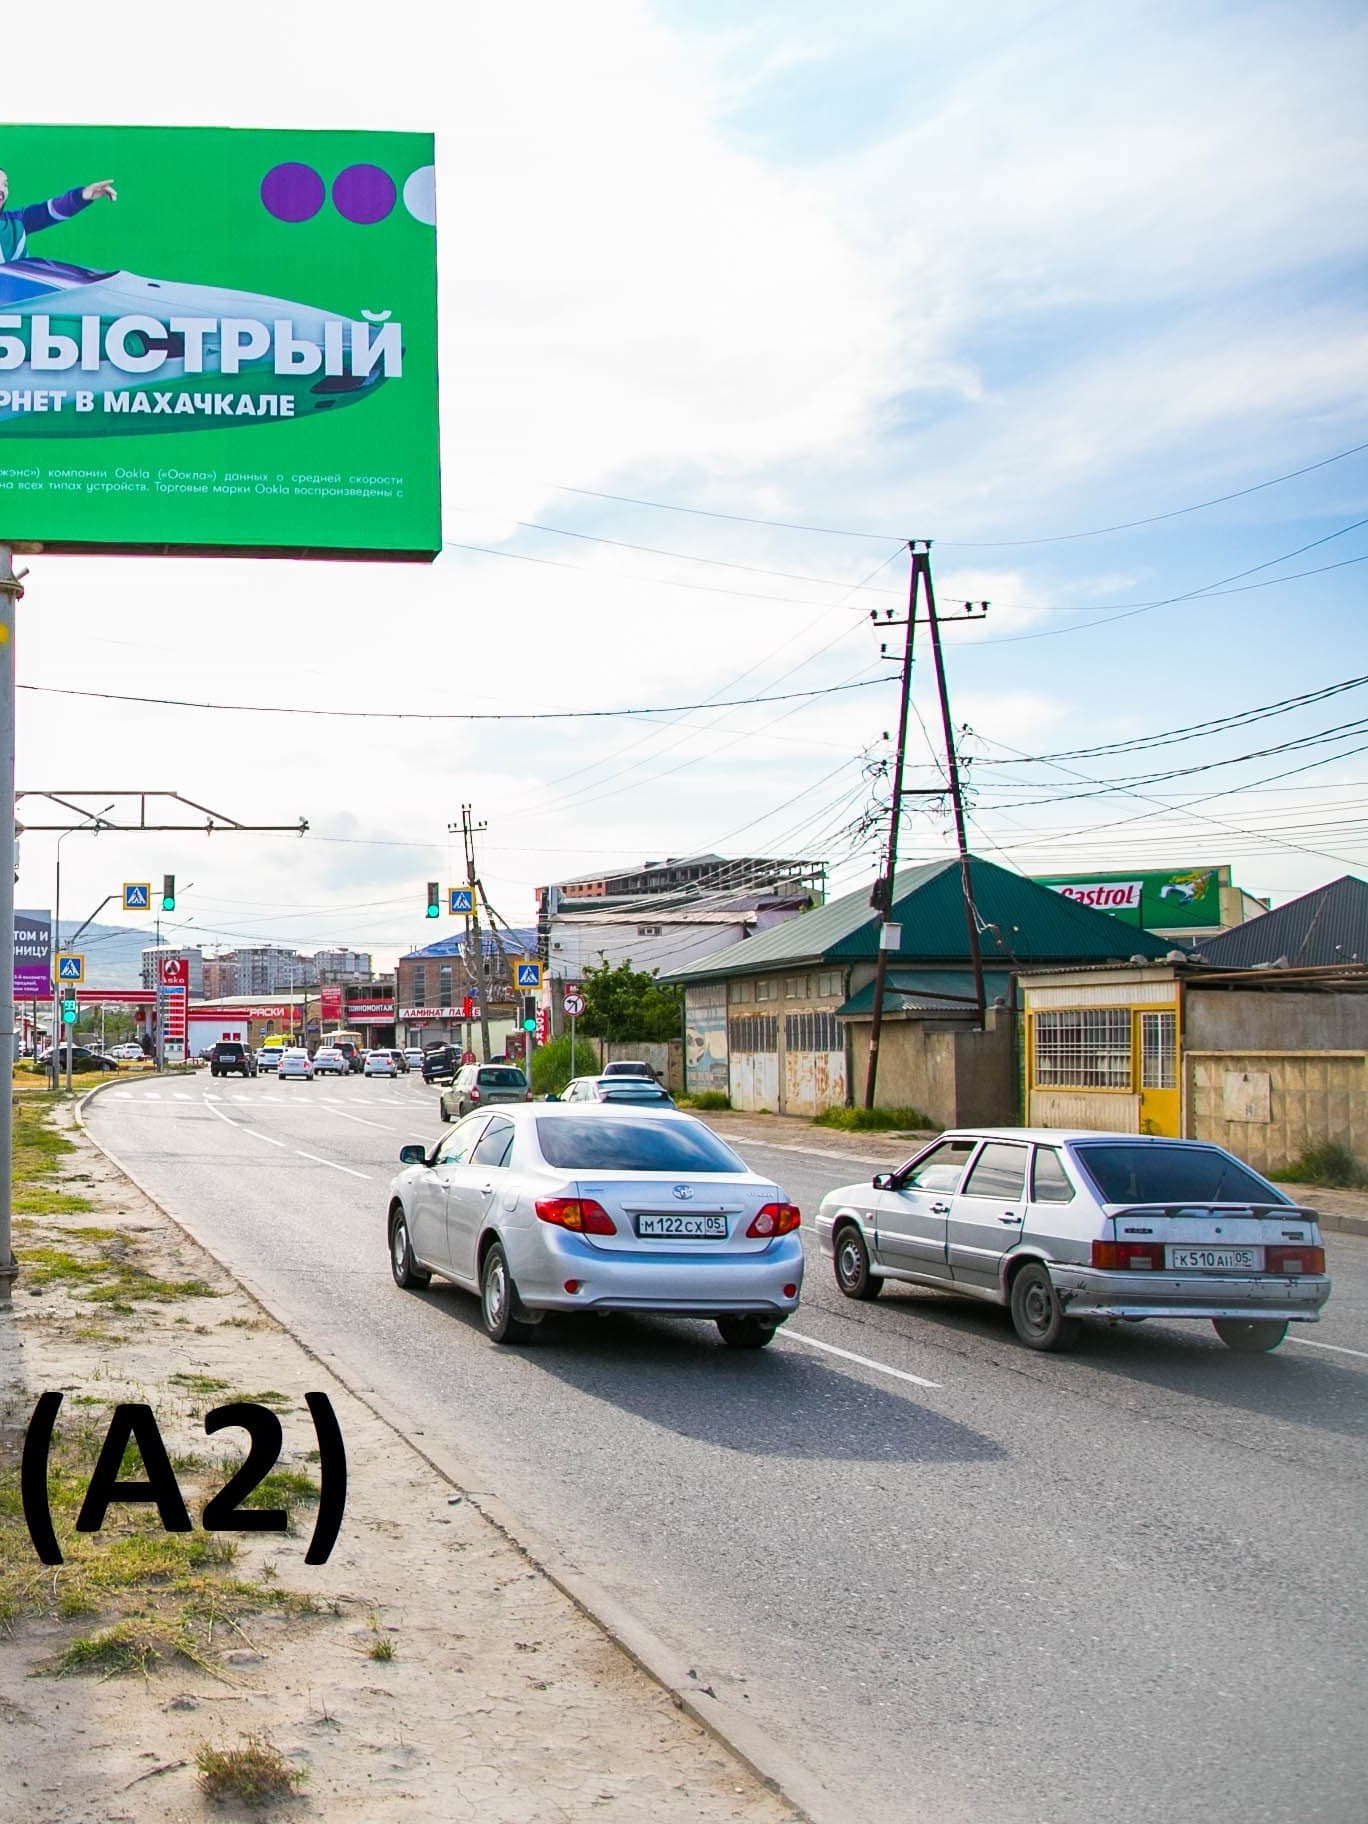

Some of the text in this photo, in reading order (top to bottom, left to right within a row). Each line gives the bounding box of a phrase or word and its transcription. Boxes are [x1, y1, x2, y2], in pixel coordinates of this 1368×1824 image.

[75, 390, 95, 412] В
[103, 391, 296, 417] МАХАЧКАЛЕ
[48, 469, 107, 478] компании
[115, 467, 149, 479] Ookla
[224, 472, 268, 483] данных
[291, 471, 341, 485] средней
[349, 475, 403, 486] скорости
[18, 481, 43, 489] всех
[48, 481, 82, 490] типах
[86, 480, 150, 494] устройств.
[155, 481, 208, 495] Торговые
[213, 484, 250, 496] марки
[255, 483, 290, 495] Ookla
[294, 487, 392, 499] воспроизведены
[14, 931, 48, 941] ТОМ И
[14, 946, 48, 957] НИЦУ
[706, 1217, 721, 1229] 05
[1235, 1252, 1249, 1262] 05
